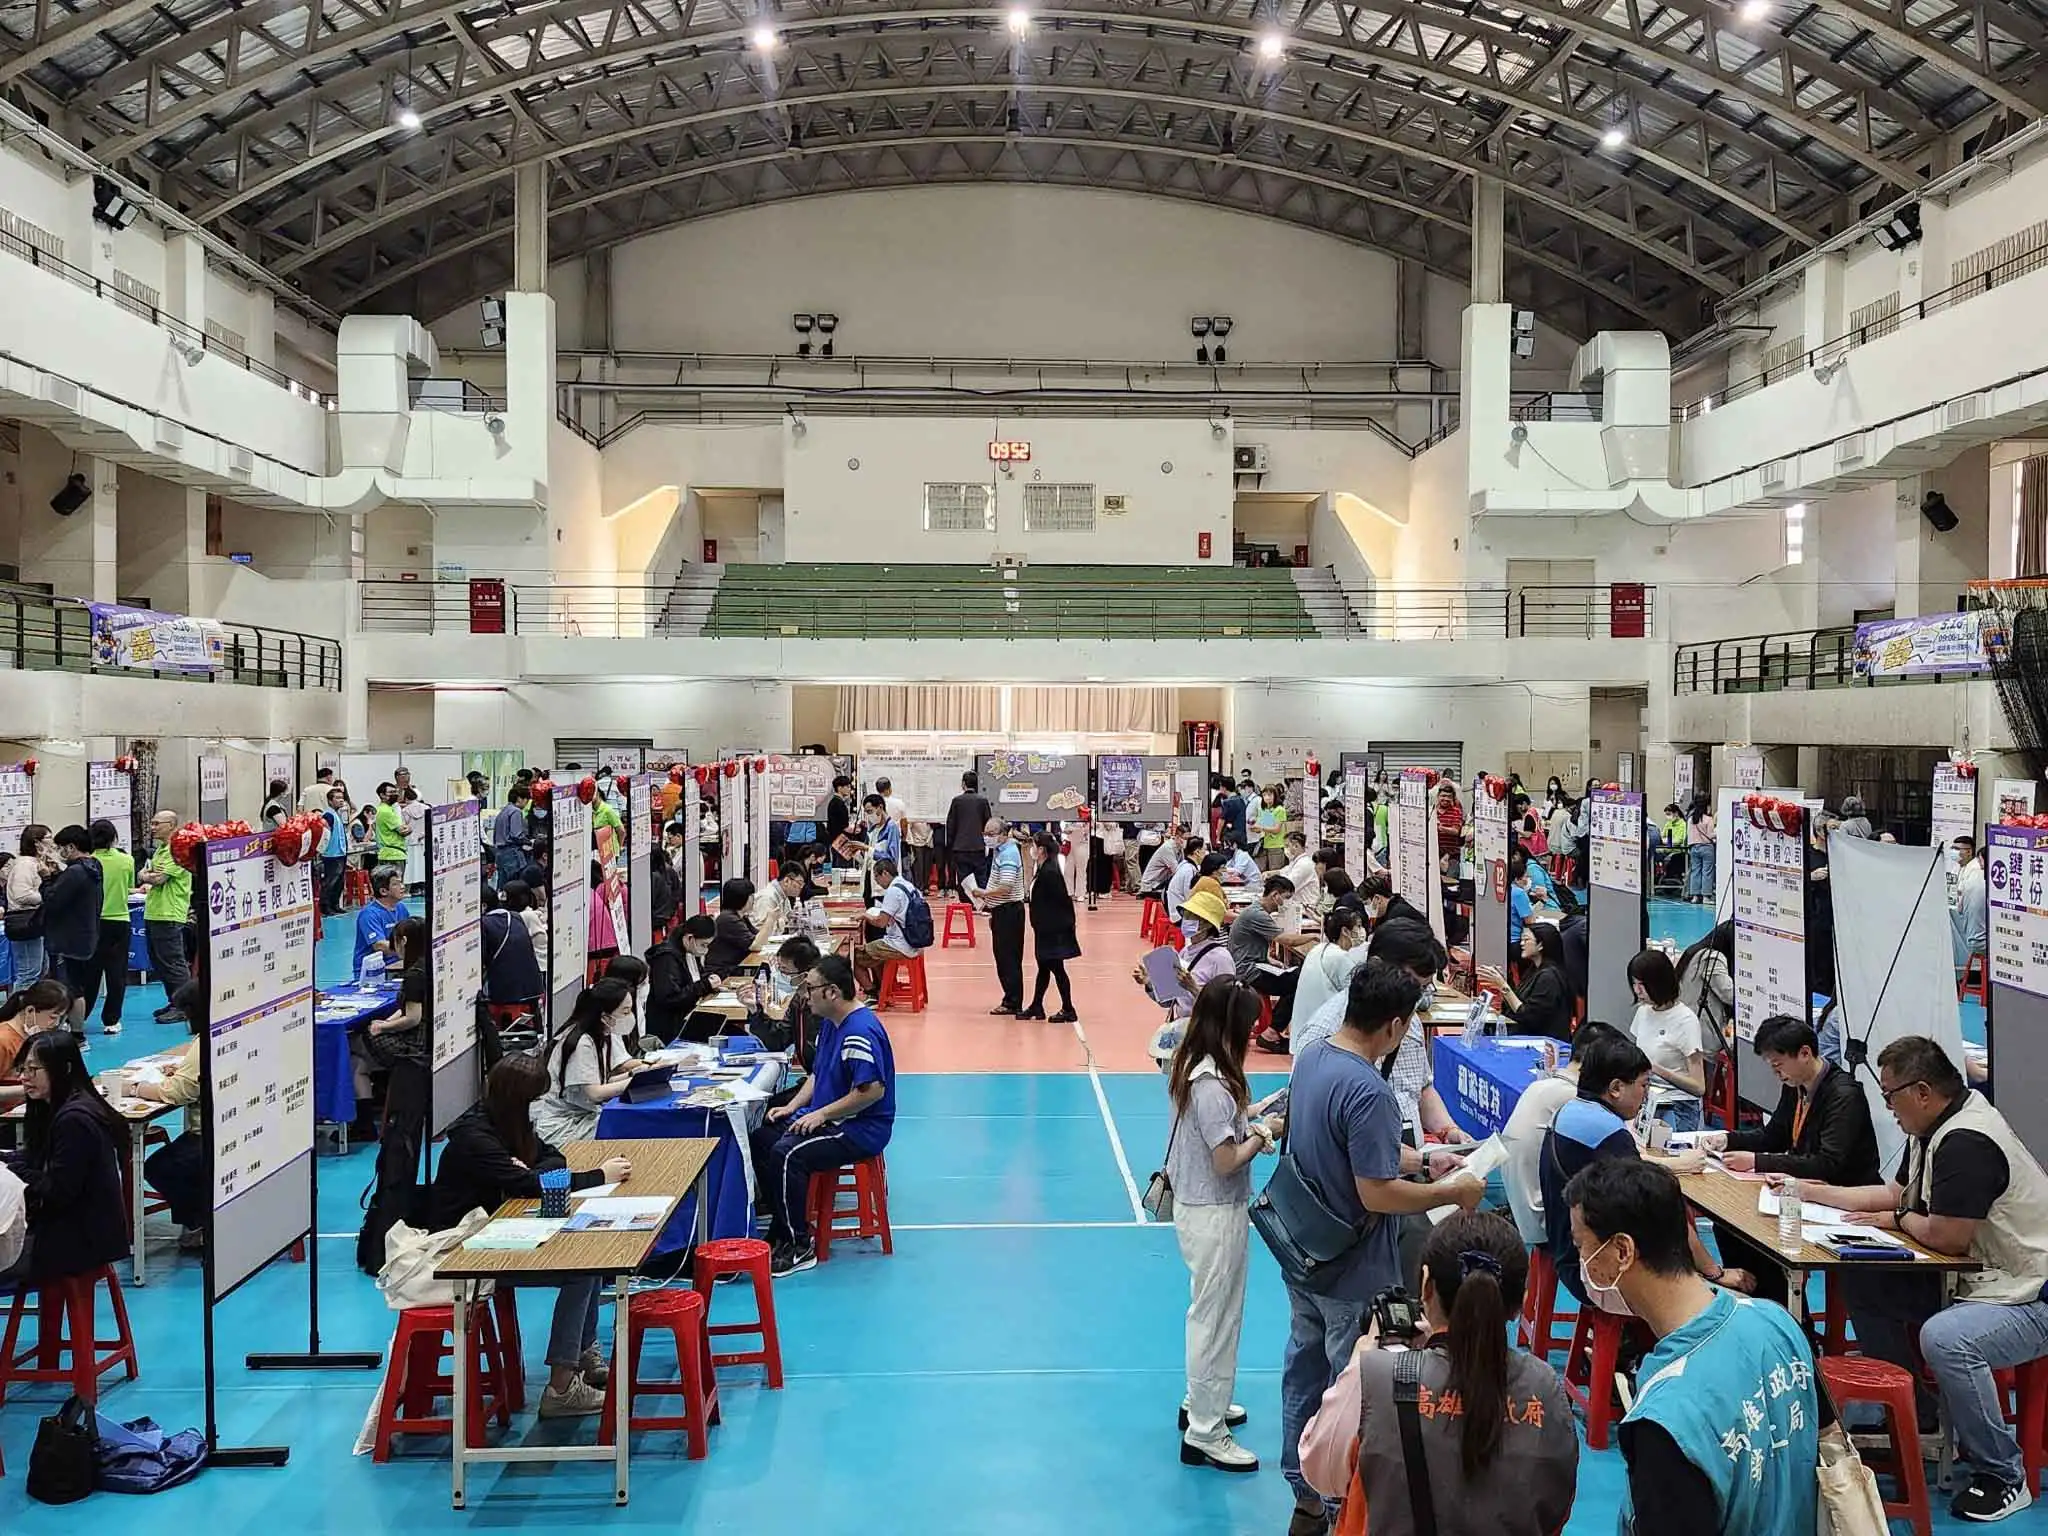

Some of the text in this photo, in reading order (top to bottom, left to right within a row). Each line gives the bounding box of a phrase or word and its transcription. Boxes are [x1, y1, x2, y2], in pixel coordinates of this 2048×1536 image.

[1992, 865, 2006, 883] 23
[211, 889, 223, 907] 22
[225, 878, 311, 921] 股份有限公司
[2009, 877, 2044, 906] 股份
[1418, 1383, 1545, 1429] 高雄府
